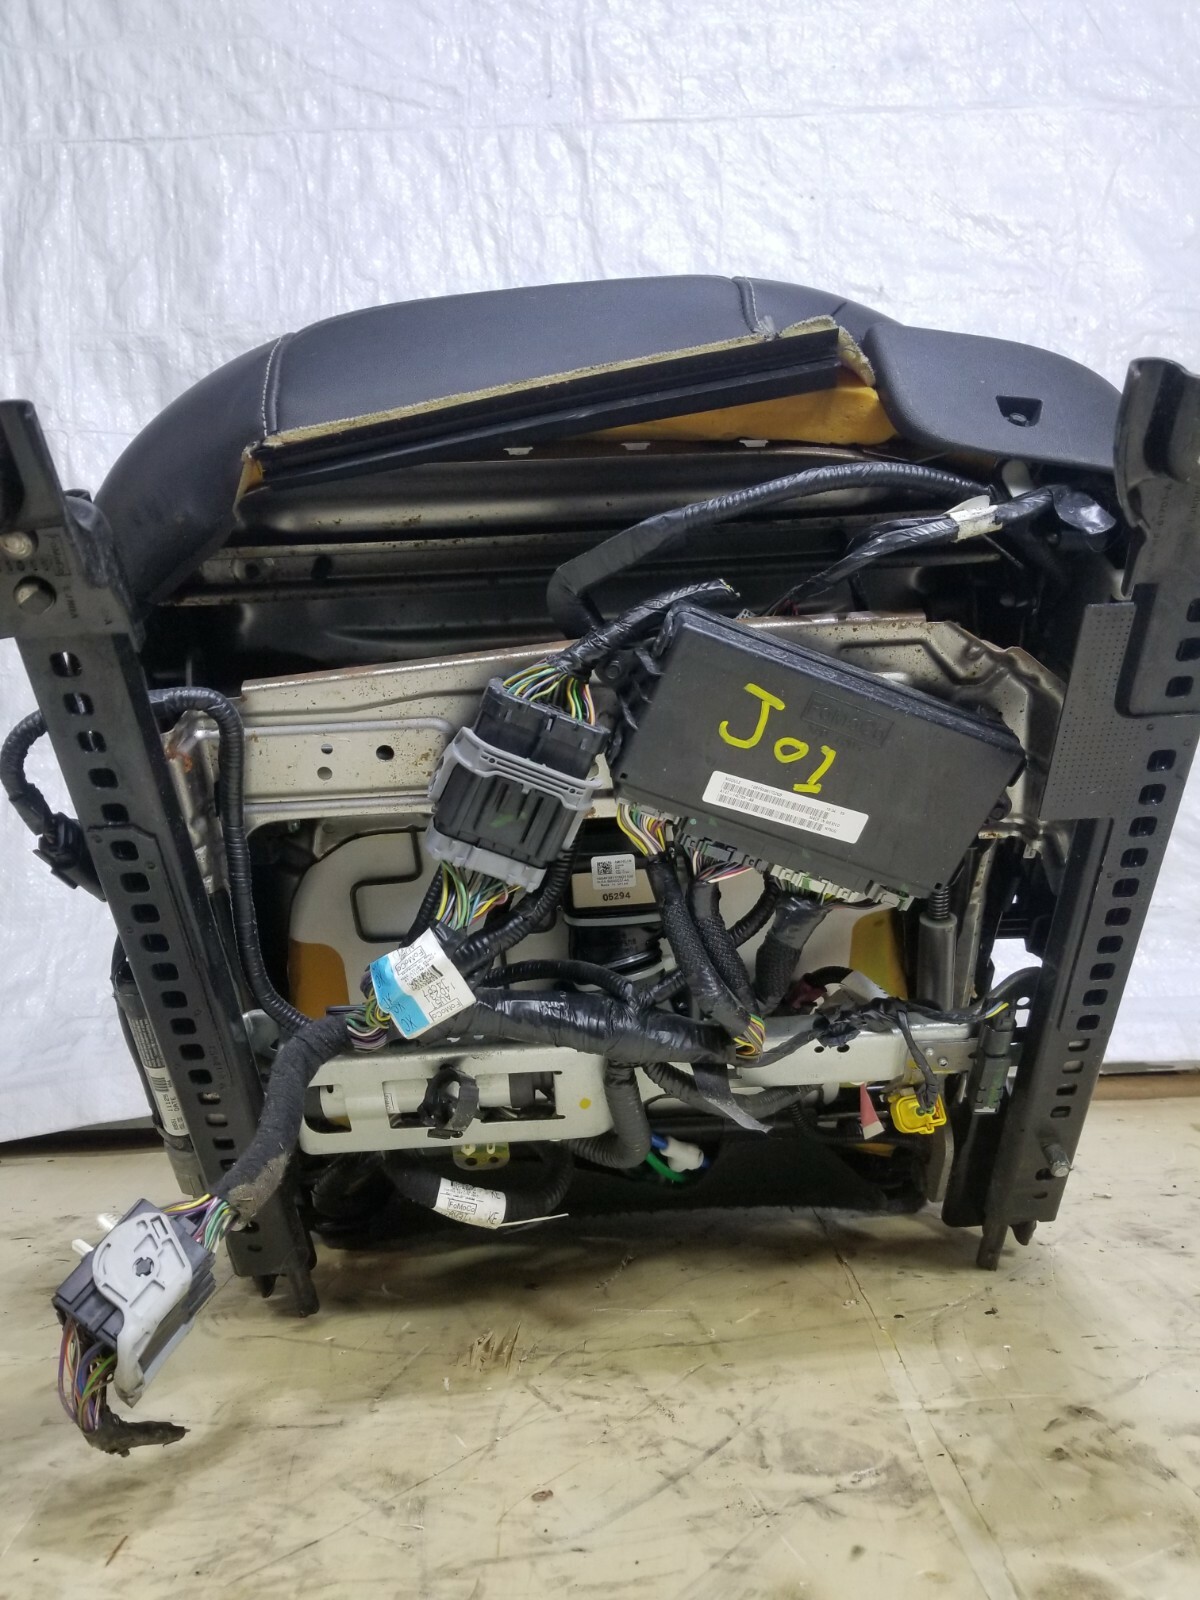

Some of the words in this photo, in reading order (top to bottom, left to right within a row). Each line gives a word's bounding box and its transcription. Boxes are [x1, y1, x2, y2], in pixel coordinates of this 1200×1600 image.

[602, 891, 631, 902] 05294
[400, 1015, 417, 1032] XC
[449, 1201, 476, 1214] FoMoCo
